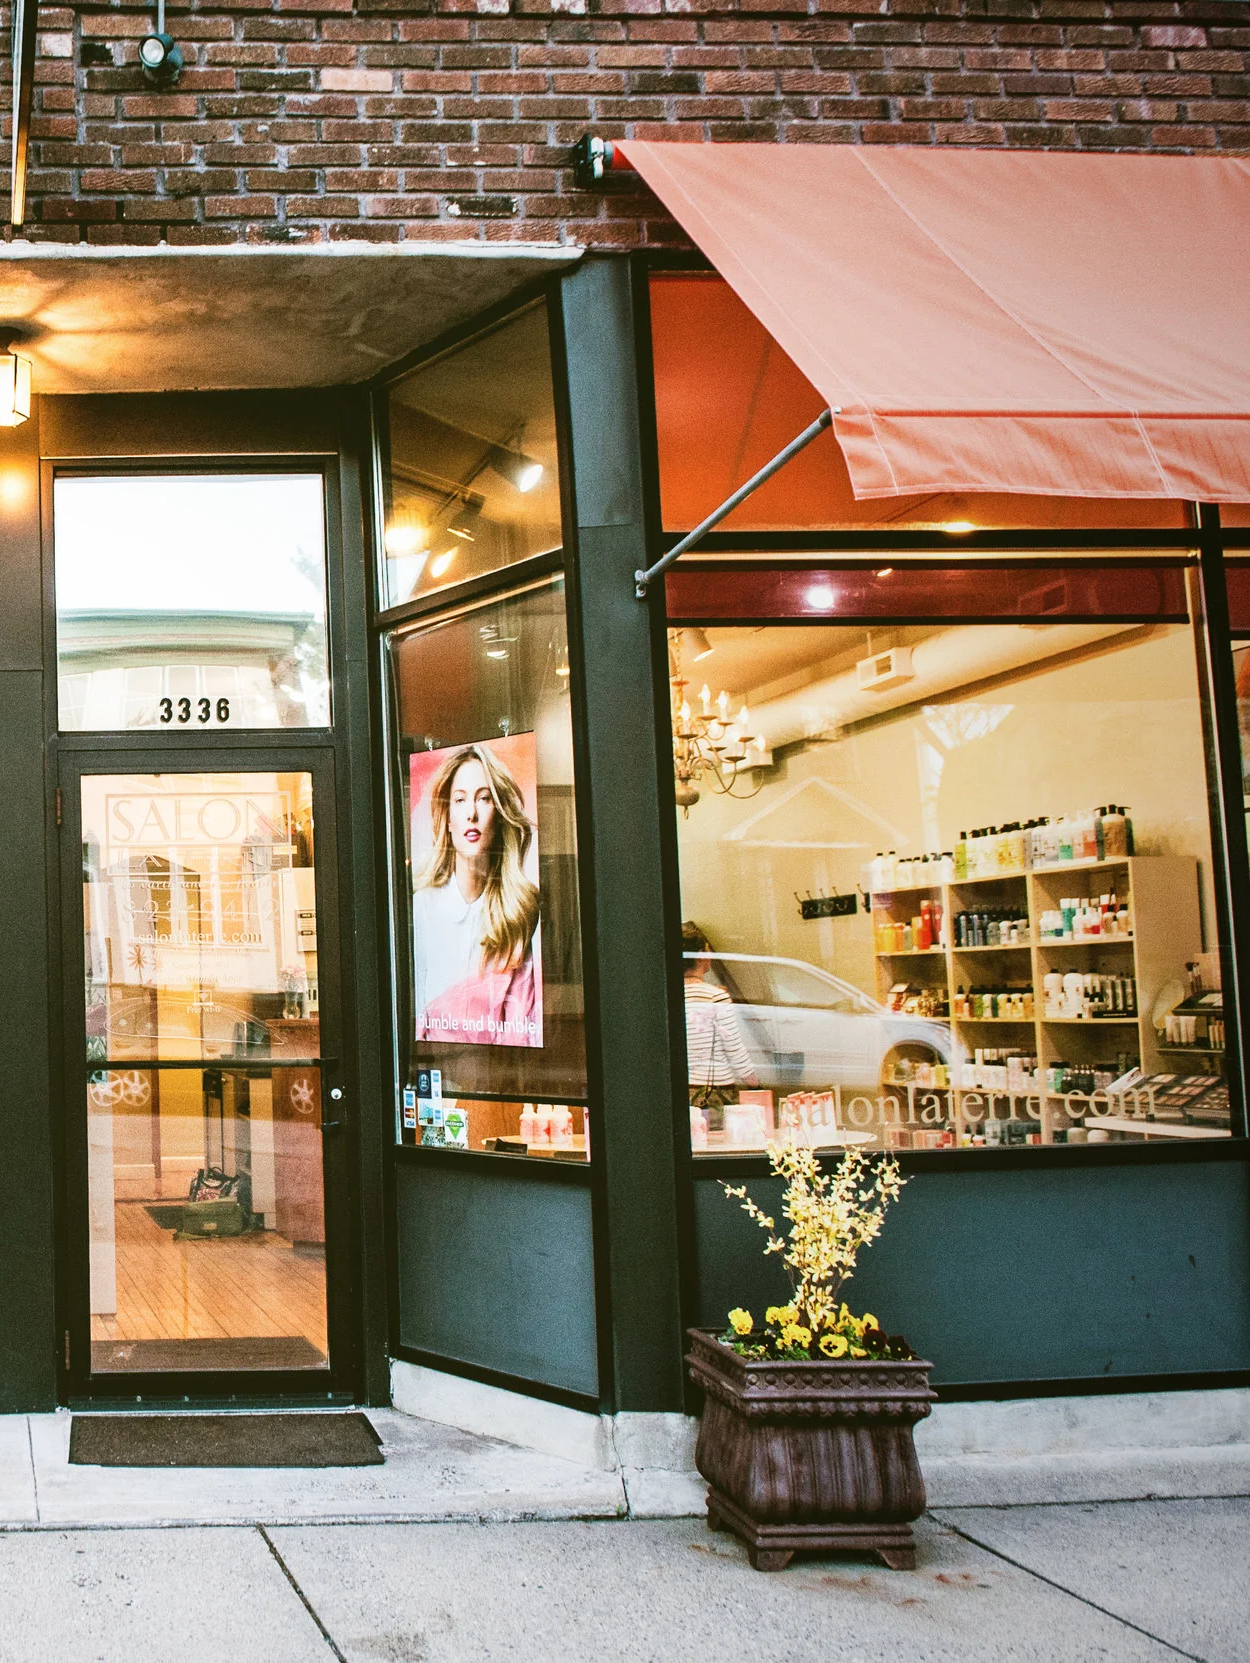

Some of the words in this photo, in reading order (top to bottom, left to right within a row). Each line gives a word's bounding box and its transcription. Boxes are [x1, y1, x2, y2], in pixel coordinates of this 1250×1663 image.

[158, 697, 231, 724] 3336
[113, 797, 286, 842] SALON
[117, 849, 163, 868] LA
[462, 1014, 484, 1032] and
[784, 1084, 1159, 1126] salonlaterre.com
